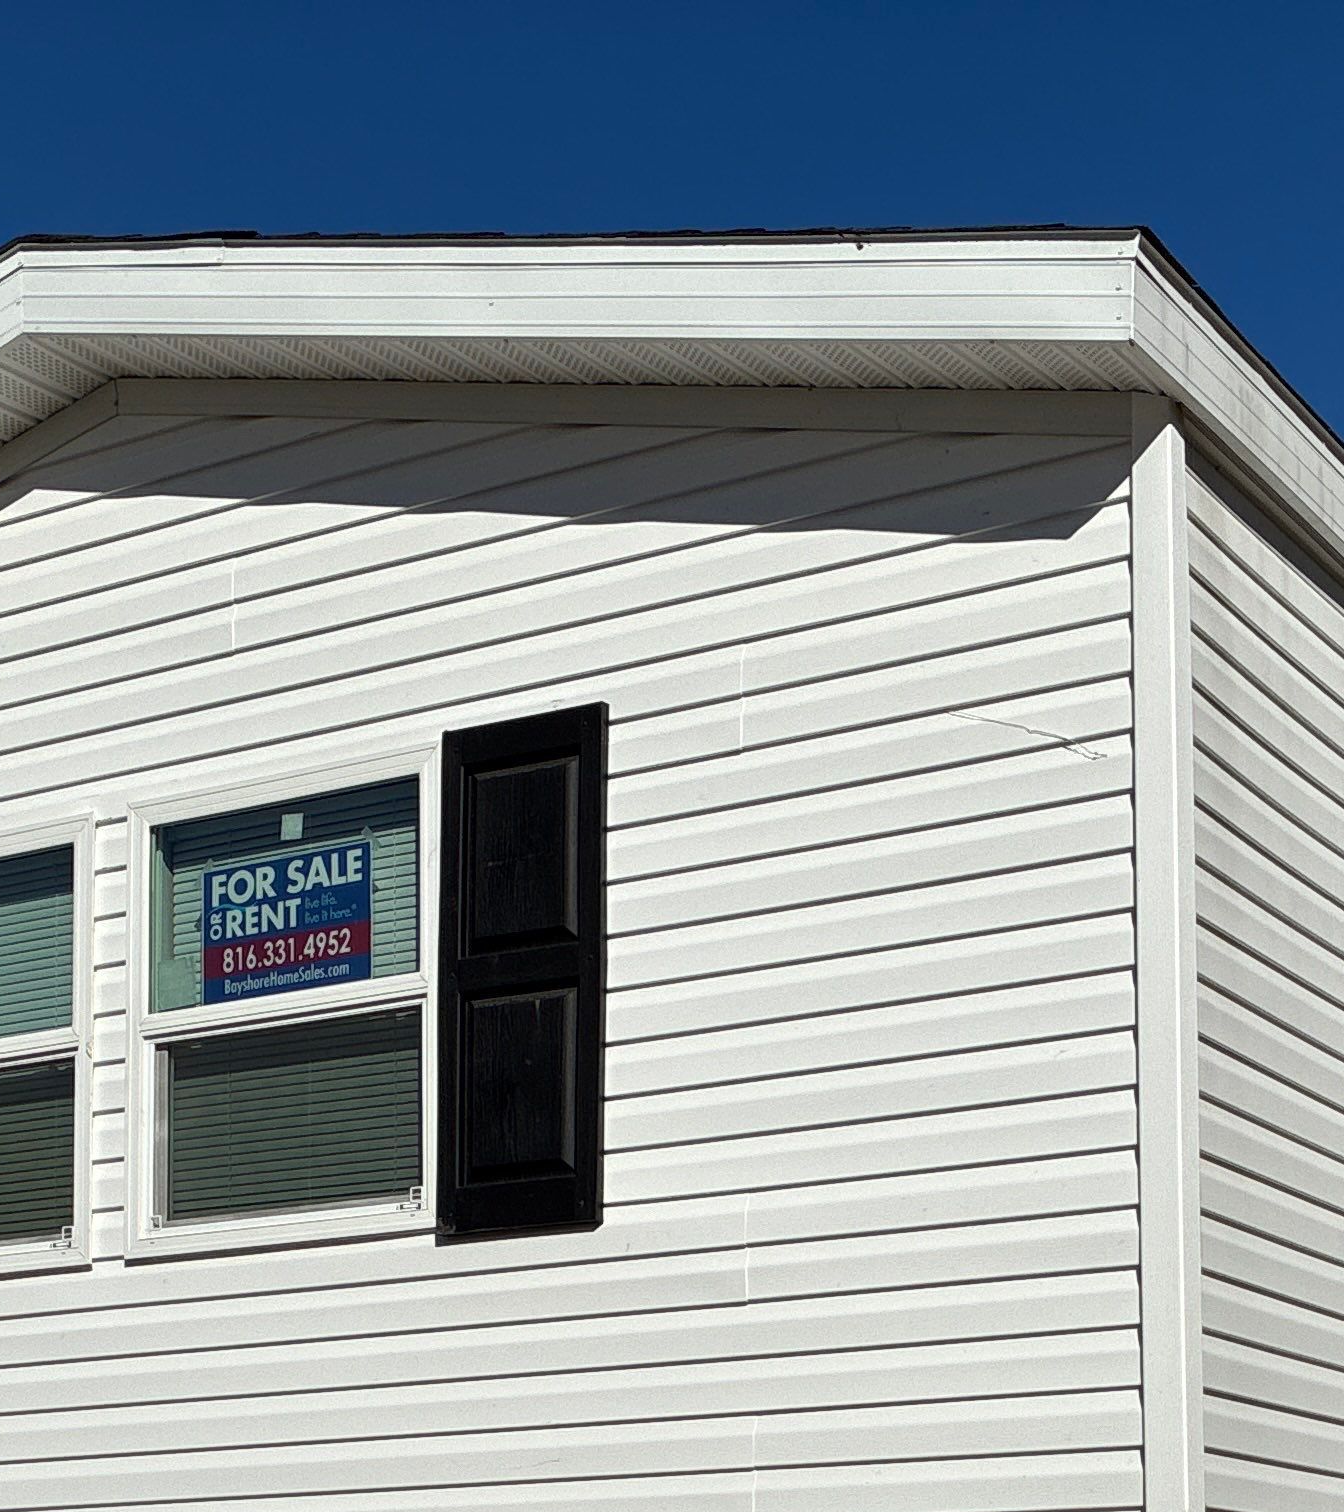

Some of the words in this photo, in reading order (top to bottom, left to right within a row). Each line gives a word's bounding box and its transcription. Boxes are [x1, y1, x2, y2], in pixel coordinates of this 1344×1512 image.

[211, 865, 276, 907] FOR
[286, 848, 363, 894] SALE
[210, 911, 223, 941] OR
[225, 898, 302, 939] RENT
[222, 928, 352, 974] 816.331.4952
[224, 963, 350, 996] BayshoreHomeSales.com
